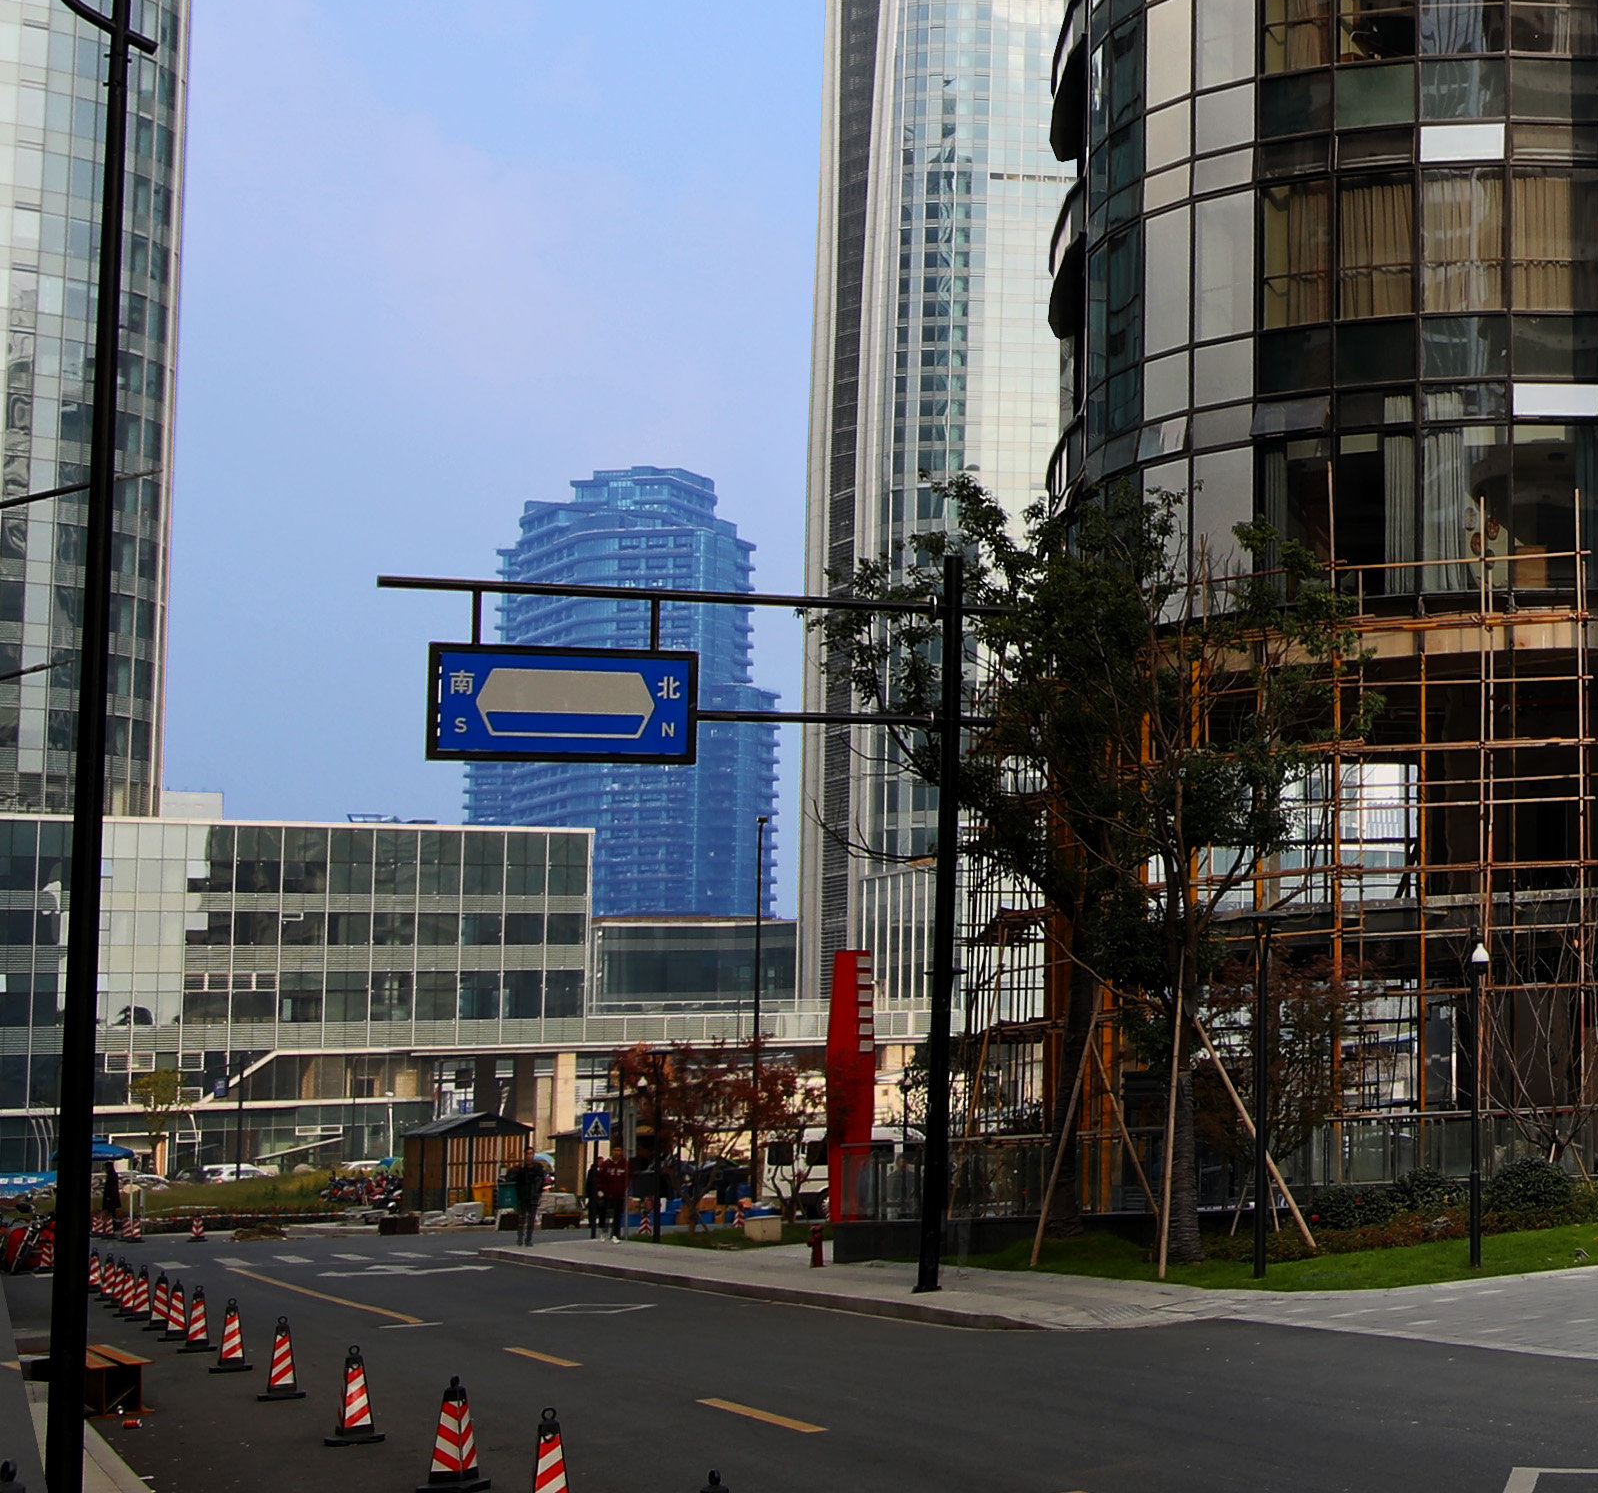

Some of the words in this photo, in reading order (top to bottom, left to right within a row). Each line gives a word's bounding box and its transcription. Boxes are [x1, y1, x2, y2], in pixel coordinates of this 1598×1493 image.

[449, 669, 475, 695] 南
[657, 676, 681, 700] 北
[454, 717, 467, 734] S
[661, 721, 675, 738] N
